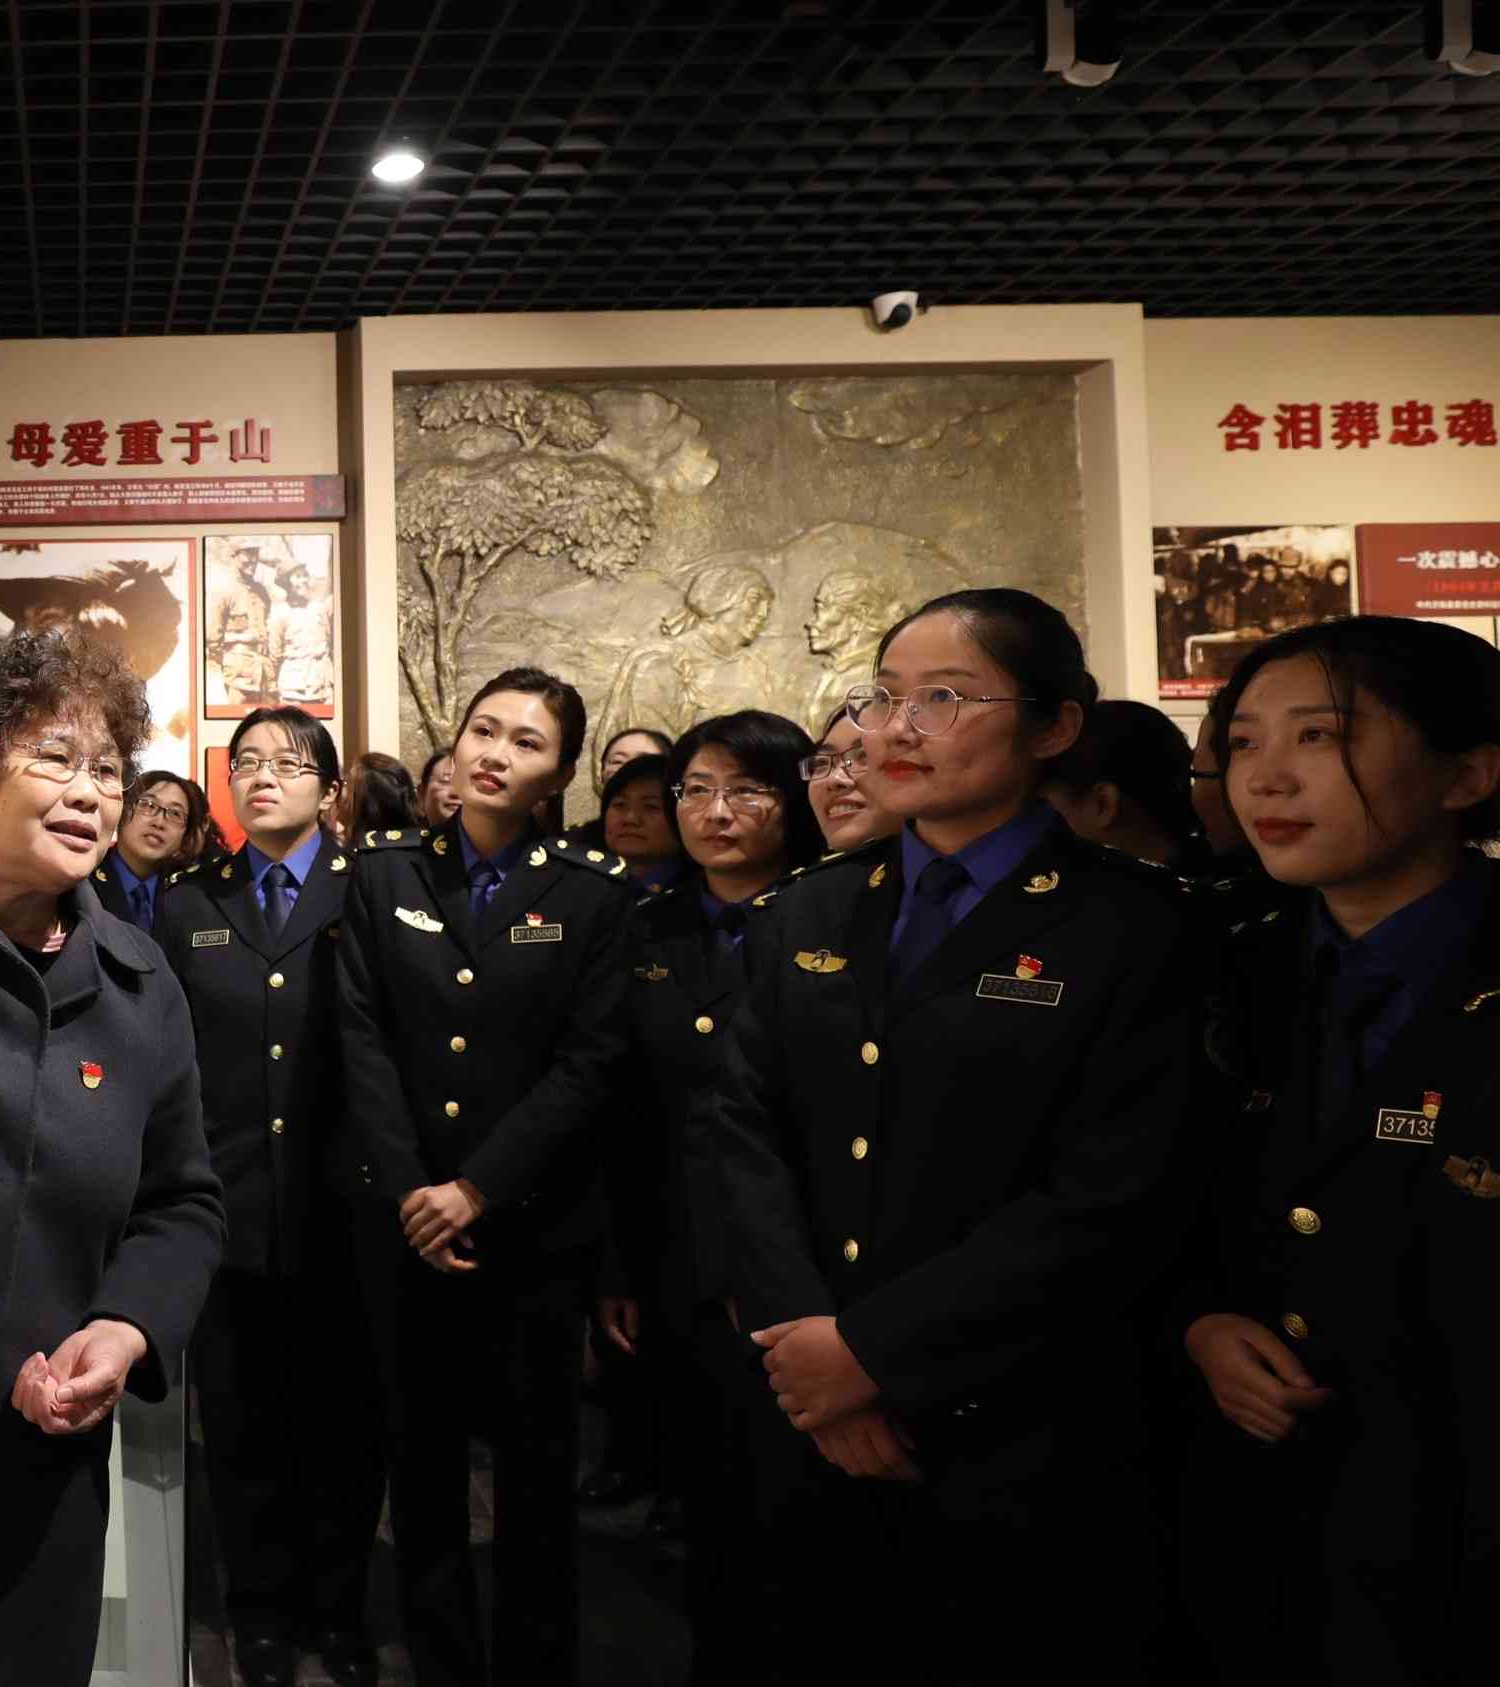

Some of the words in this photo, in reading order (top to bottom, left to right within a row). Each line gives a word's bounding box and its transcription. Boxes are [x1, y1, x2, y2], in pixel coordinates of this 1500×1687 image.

[6, 418, 271, 468] 母爱重于山
[1217, 399, 1498, 452] 含泪葬忠魂
